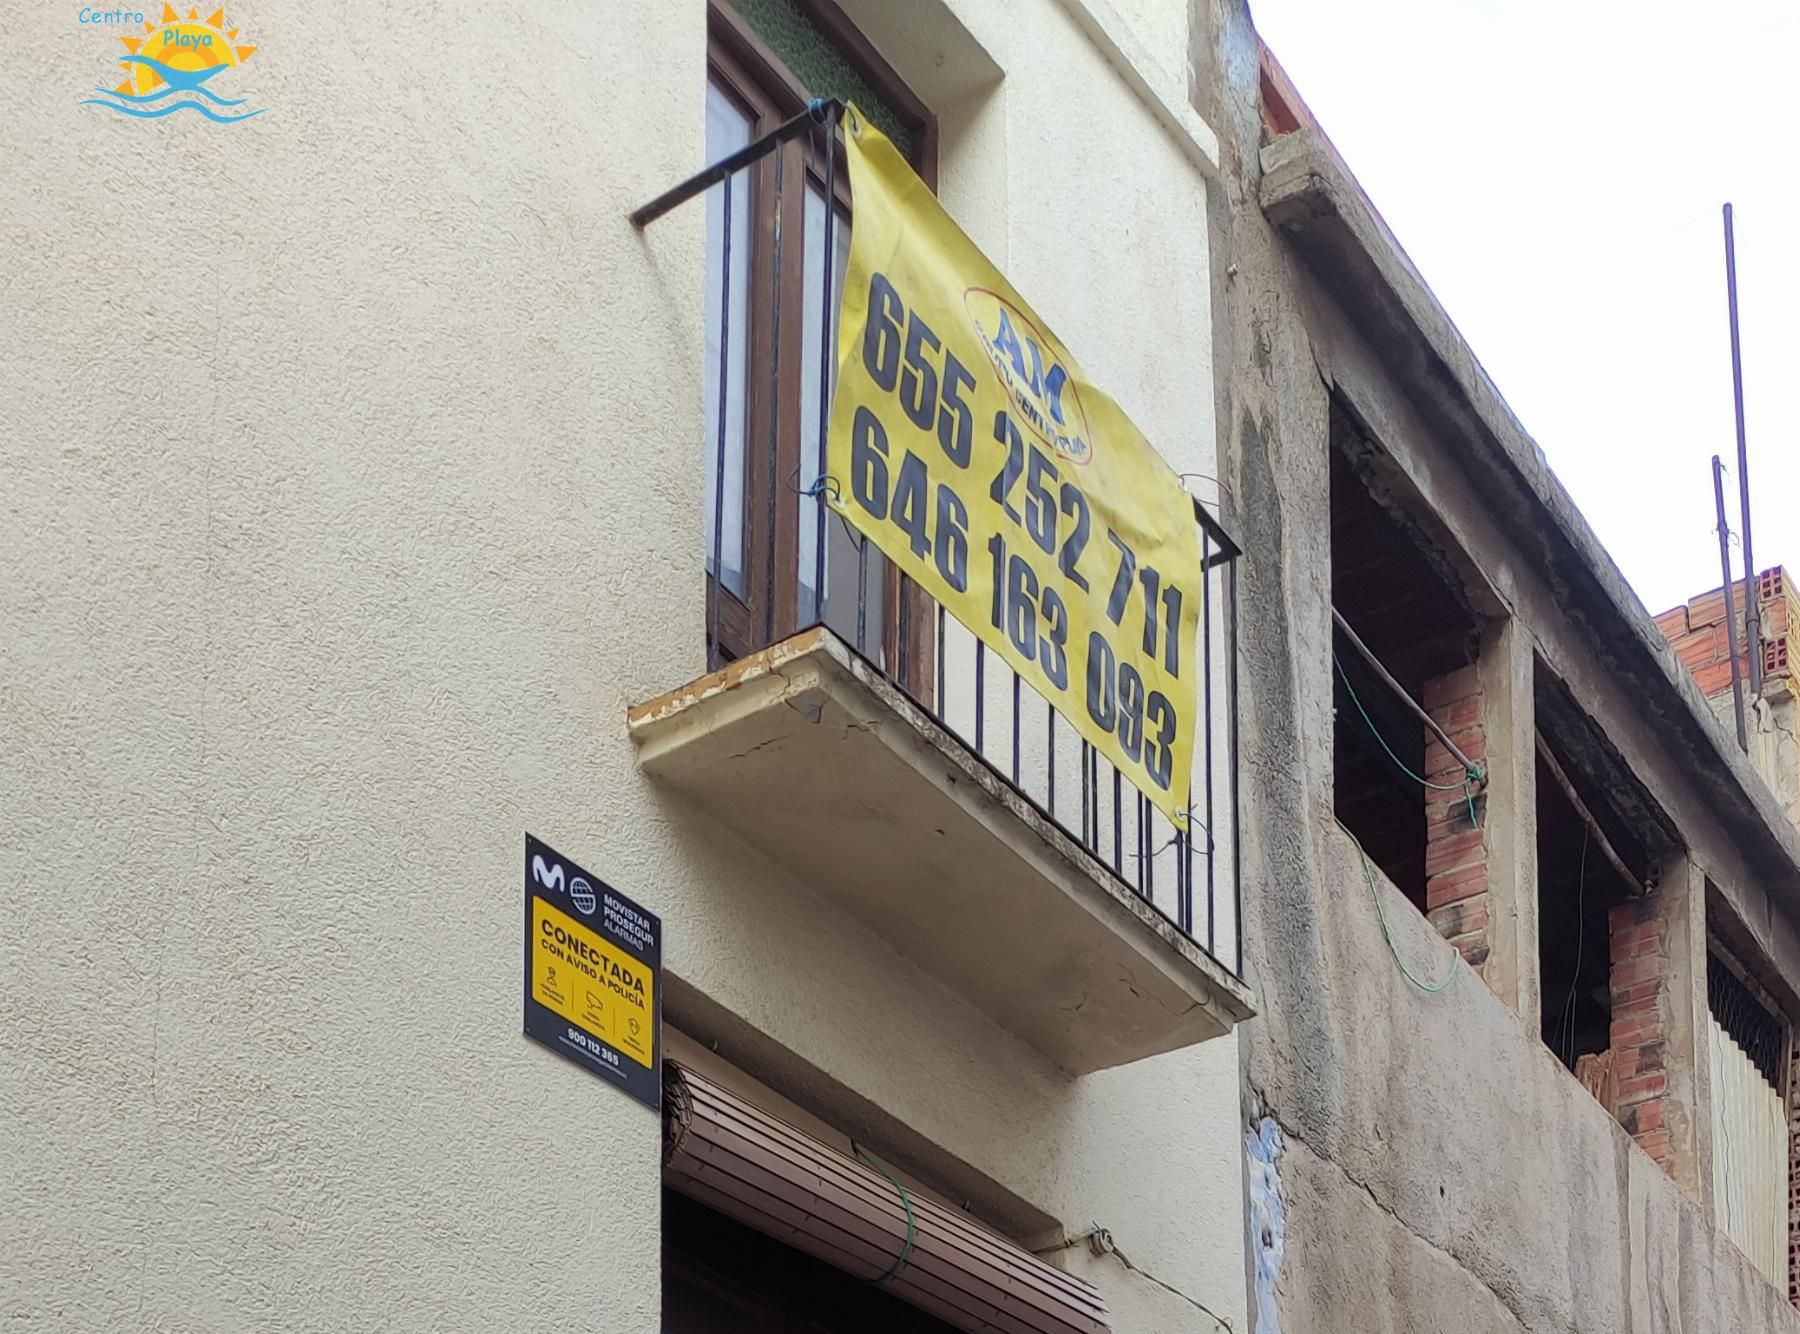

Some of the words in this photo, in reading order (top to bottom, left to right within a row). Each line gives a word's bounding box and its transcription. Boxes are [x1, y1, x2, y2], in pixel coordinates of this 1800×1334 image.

[992, 307, 1068, 427] AM
[863, 271, 977, 470] 655
[989, 409, 1091, 595] 252
[1106, 526, 1184, 682] 711
[850, 404, 969, 594] 646
[988, 531, 1068, 693] 163
[1086, 629, 1178, 792] 093
[603, 893, 651, 932] MOVISTAR
[603, 906, 655, 947] PROSEGUR
[603, 918, 644, 951] ALARMAS
[541, 918, 645, 996] CONECTADA
[541, 938, 565, 960] CON
[566, 953, 597, 979] AVISO
[598, 974, 606, 986] A
[608, 979, 645, 1010] POLICÍA
[567, 1027, 586, 1048] 900
[587, 1039, 601, 1056] 112
